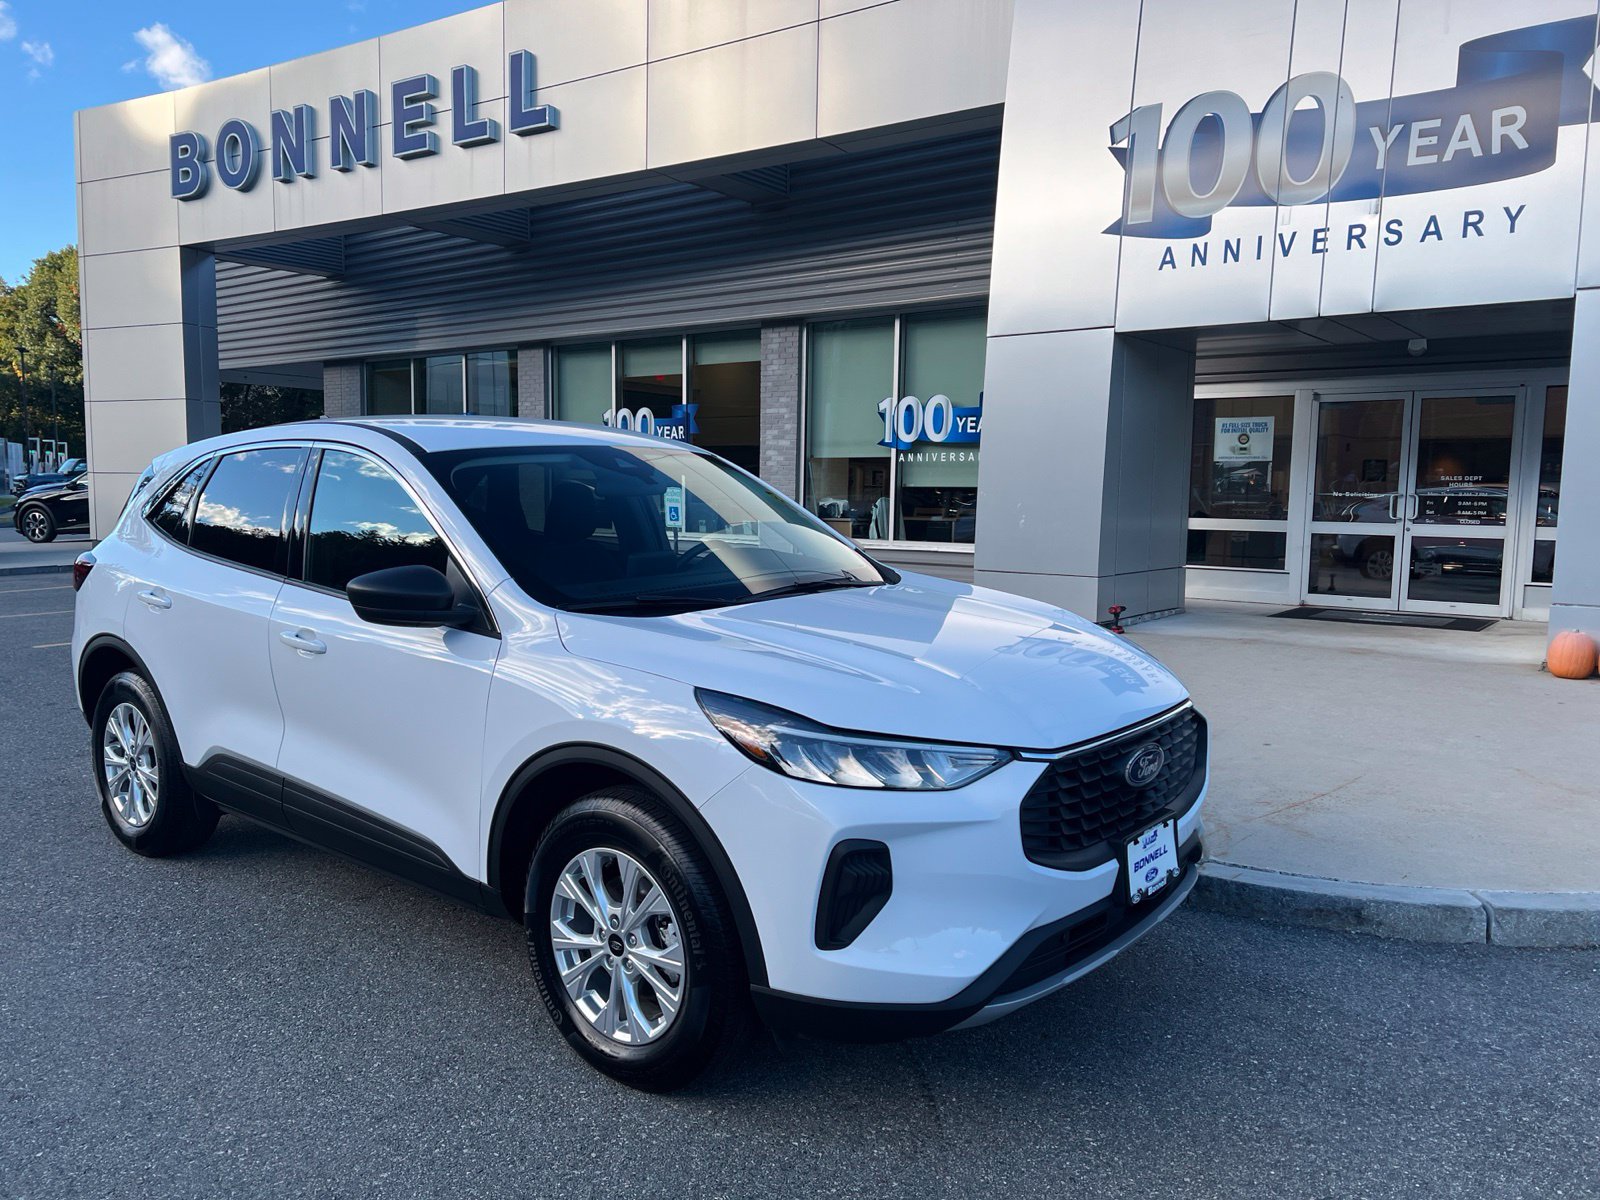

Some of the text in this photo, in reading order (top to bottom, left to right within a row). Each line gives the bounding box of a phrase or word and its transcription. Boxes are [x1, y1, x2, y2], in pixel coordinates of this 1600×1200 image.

[169, 49, 560, 202] BONNELL
[1109, 71, 1529, 224] 100 YEAR
[1158, 204, 1527, 271] ANNIVERSARY
[656, 425, 685, 439] YEAR
[878, 394, 983, 443] 100 YE
[898, 452, 981, 462] ANNIVERSA
[1134, 844, 1168, 873] BONNELL
[660, 863, 706, 954] Continental
